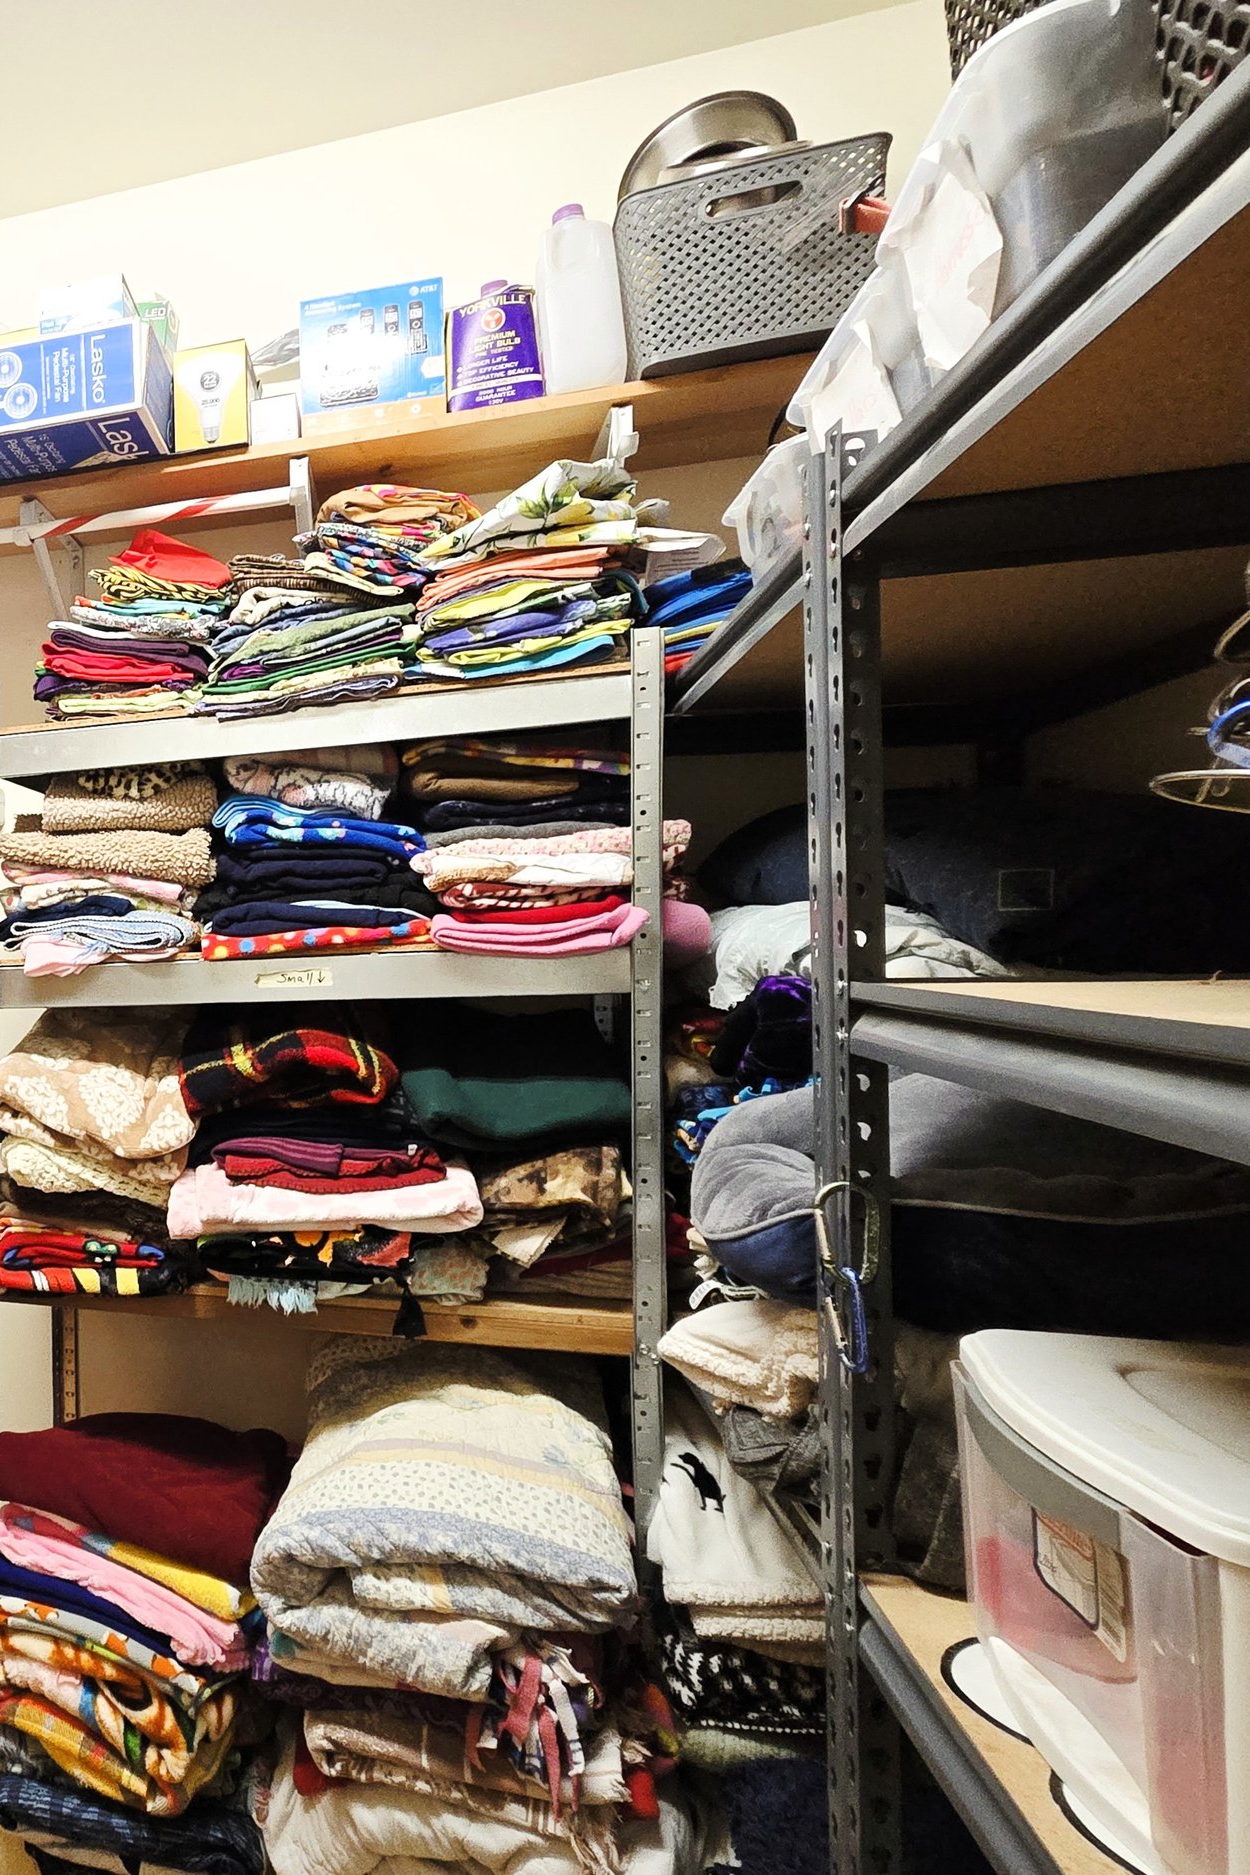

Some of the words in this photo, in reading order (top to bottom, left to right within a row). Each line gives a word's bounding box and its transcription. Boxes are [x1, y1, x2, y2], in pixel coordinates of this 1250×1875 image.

[419, 284, 438, 294] AT&T
[459, 294, 527, 318] YORKVILLE
[144, 307, 167, 318] LED
[496, 337, 521, 348] BULB
[491, 355, 508, 364] LIFE
[90, 334, 107, 403] Lasko
[507, 367, 534, 376] BEAUTY
